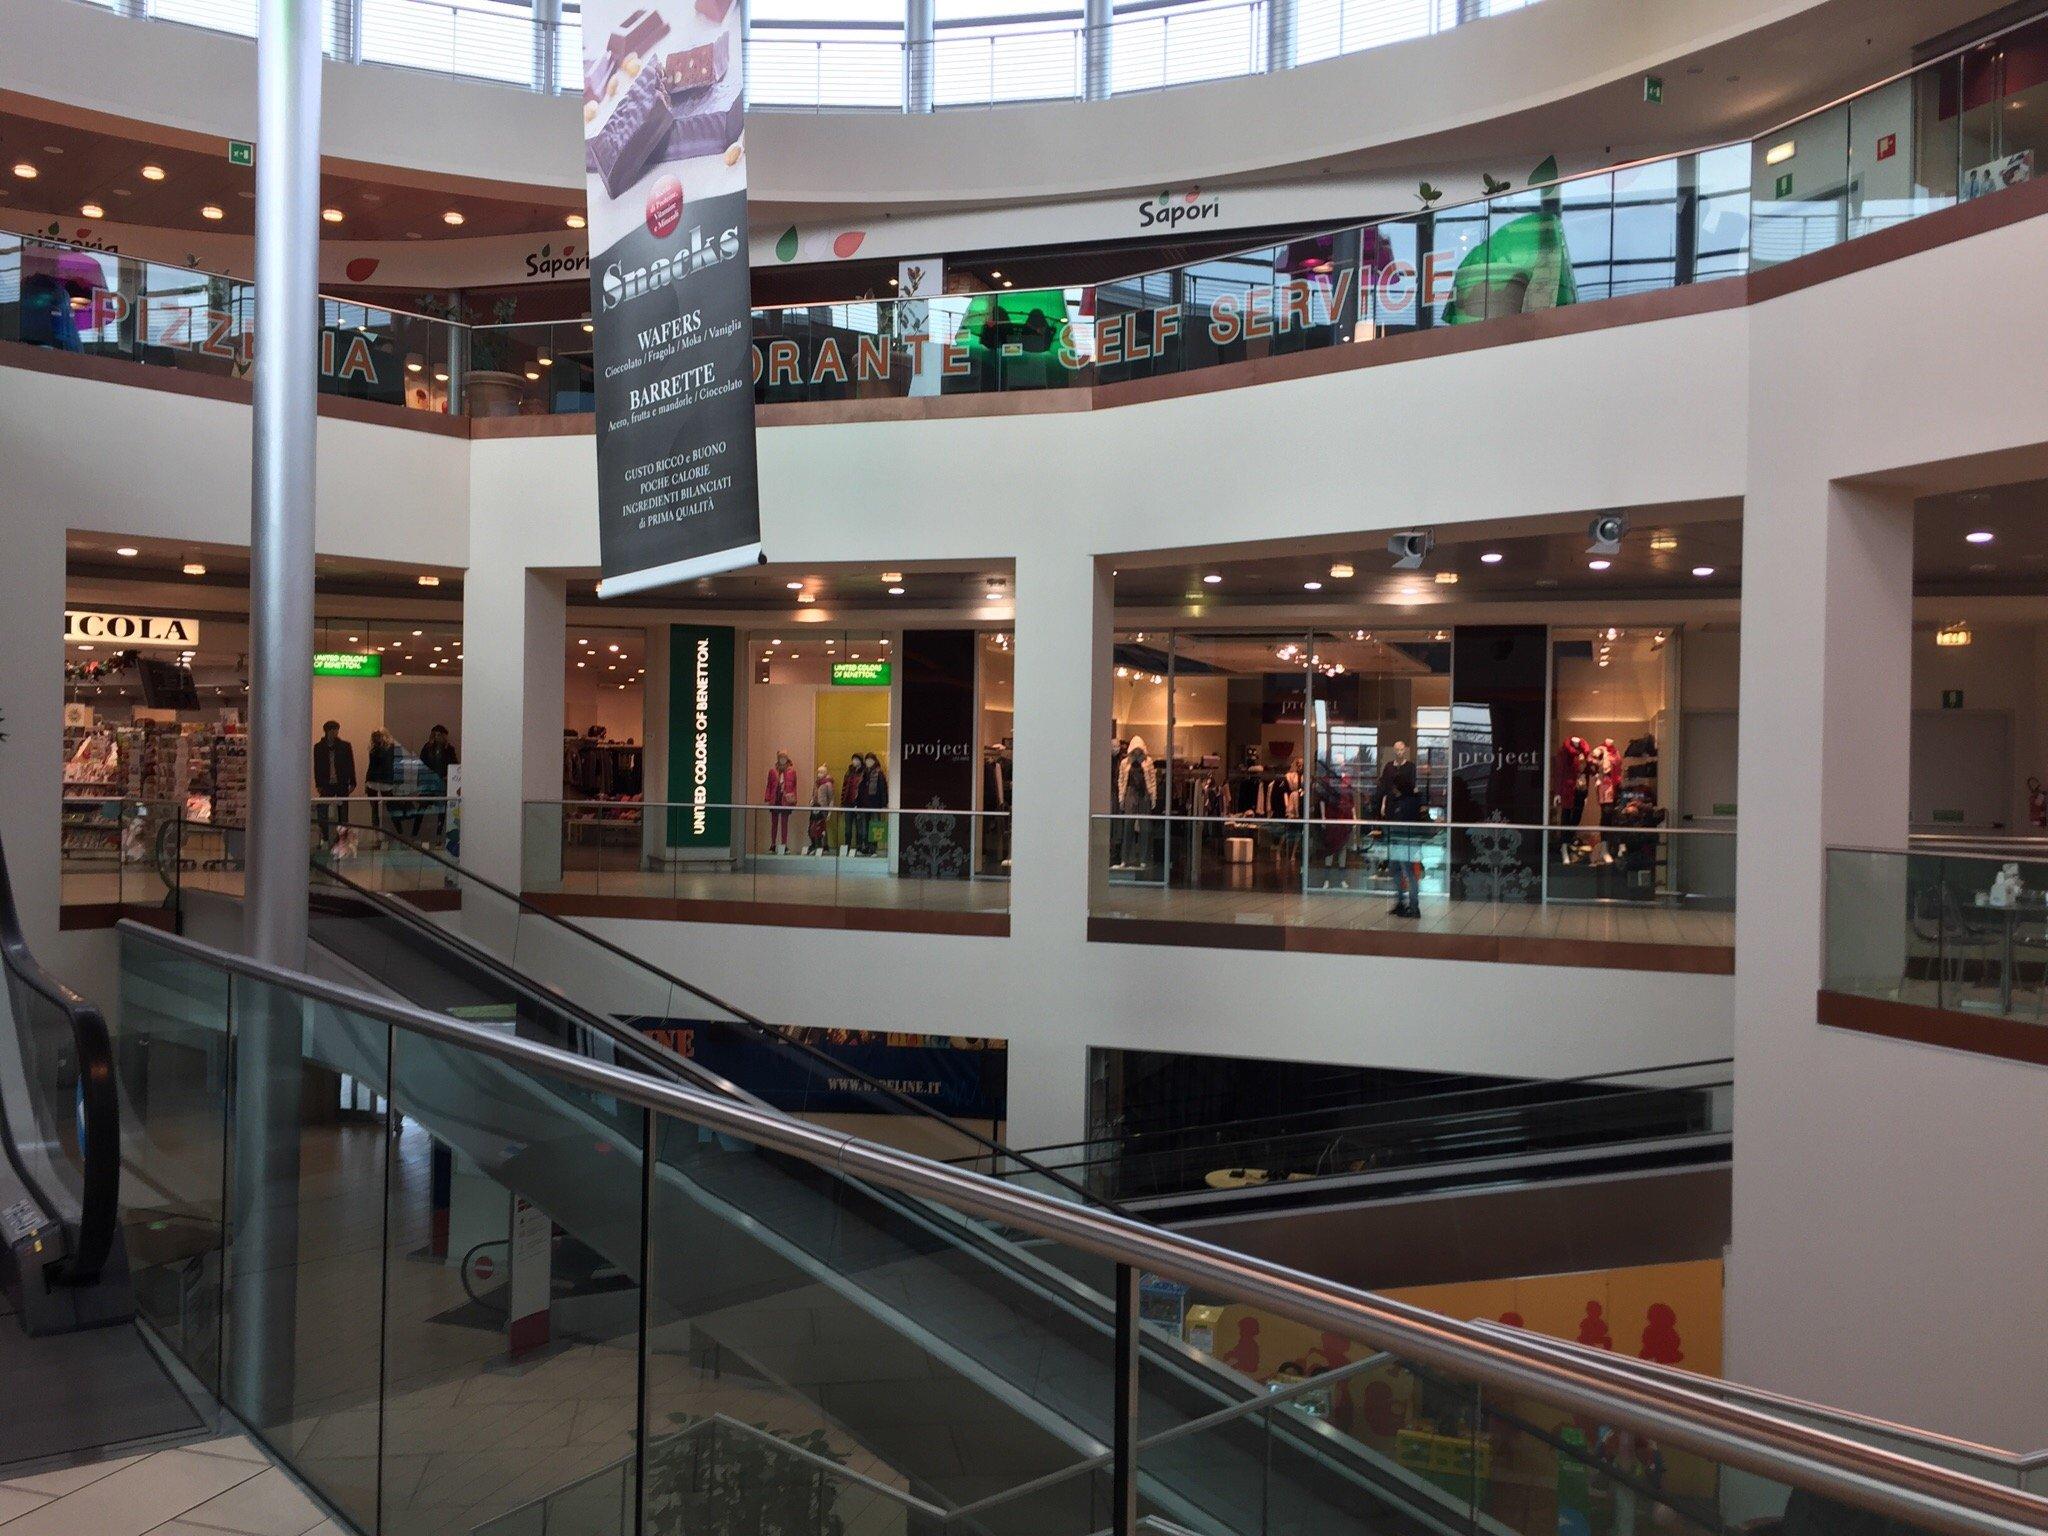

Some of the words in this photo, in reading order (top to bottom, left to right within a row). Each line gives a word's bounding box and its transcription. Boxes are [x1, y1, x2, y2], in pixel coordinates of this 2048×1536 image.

[1139, 196, 1219, 229] Sapori
[525, 251, 589, 279] Sapori
[603, 226, 739, 312] Snacks
[637, 310, 701, 351] WAFERS
[1058, 303, 1183, 370] SELF
[1208, 251, 1458, 345] SERVICE
[92, 286, 379, 384] PIZZIA
[605, 358, 642, 378] Cioccolato
[648, 344, 675, 362] Fragola
[681, 334, 702, 350] Moka
[709, 319, 742, 339] Vaniglia
[629, 362, 716, 411] BARRETTE
[631, 410, 651, 423] frutta
[658, 394, 693, 415] mandorle
[699, 379, 743, 400] Cioccolato
[624, 463, 655, 482] GUSTO
[656, 453, 684, 473] RICCO
[692, 440, 727, 462] BUONO
[640, 475, 670, 495] POCHE
[671, 463, 711, 485] CALORIE
[622, 490, 679, 517] INGREDIENTI
[680, 475, 732, 501] BILANCIATI
[647, 510, 674, 528] PRIMA
[695, 711, 708, 731] OF
[694, 732, 708, 785] COLORS
[903, 739, 969, 761] project
[1458, 747, 1538, 771] project
[694, 785, 707, 834] UNITED
